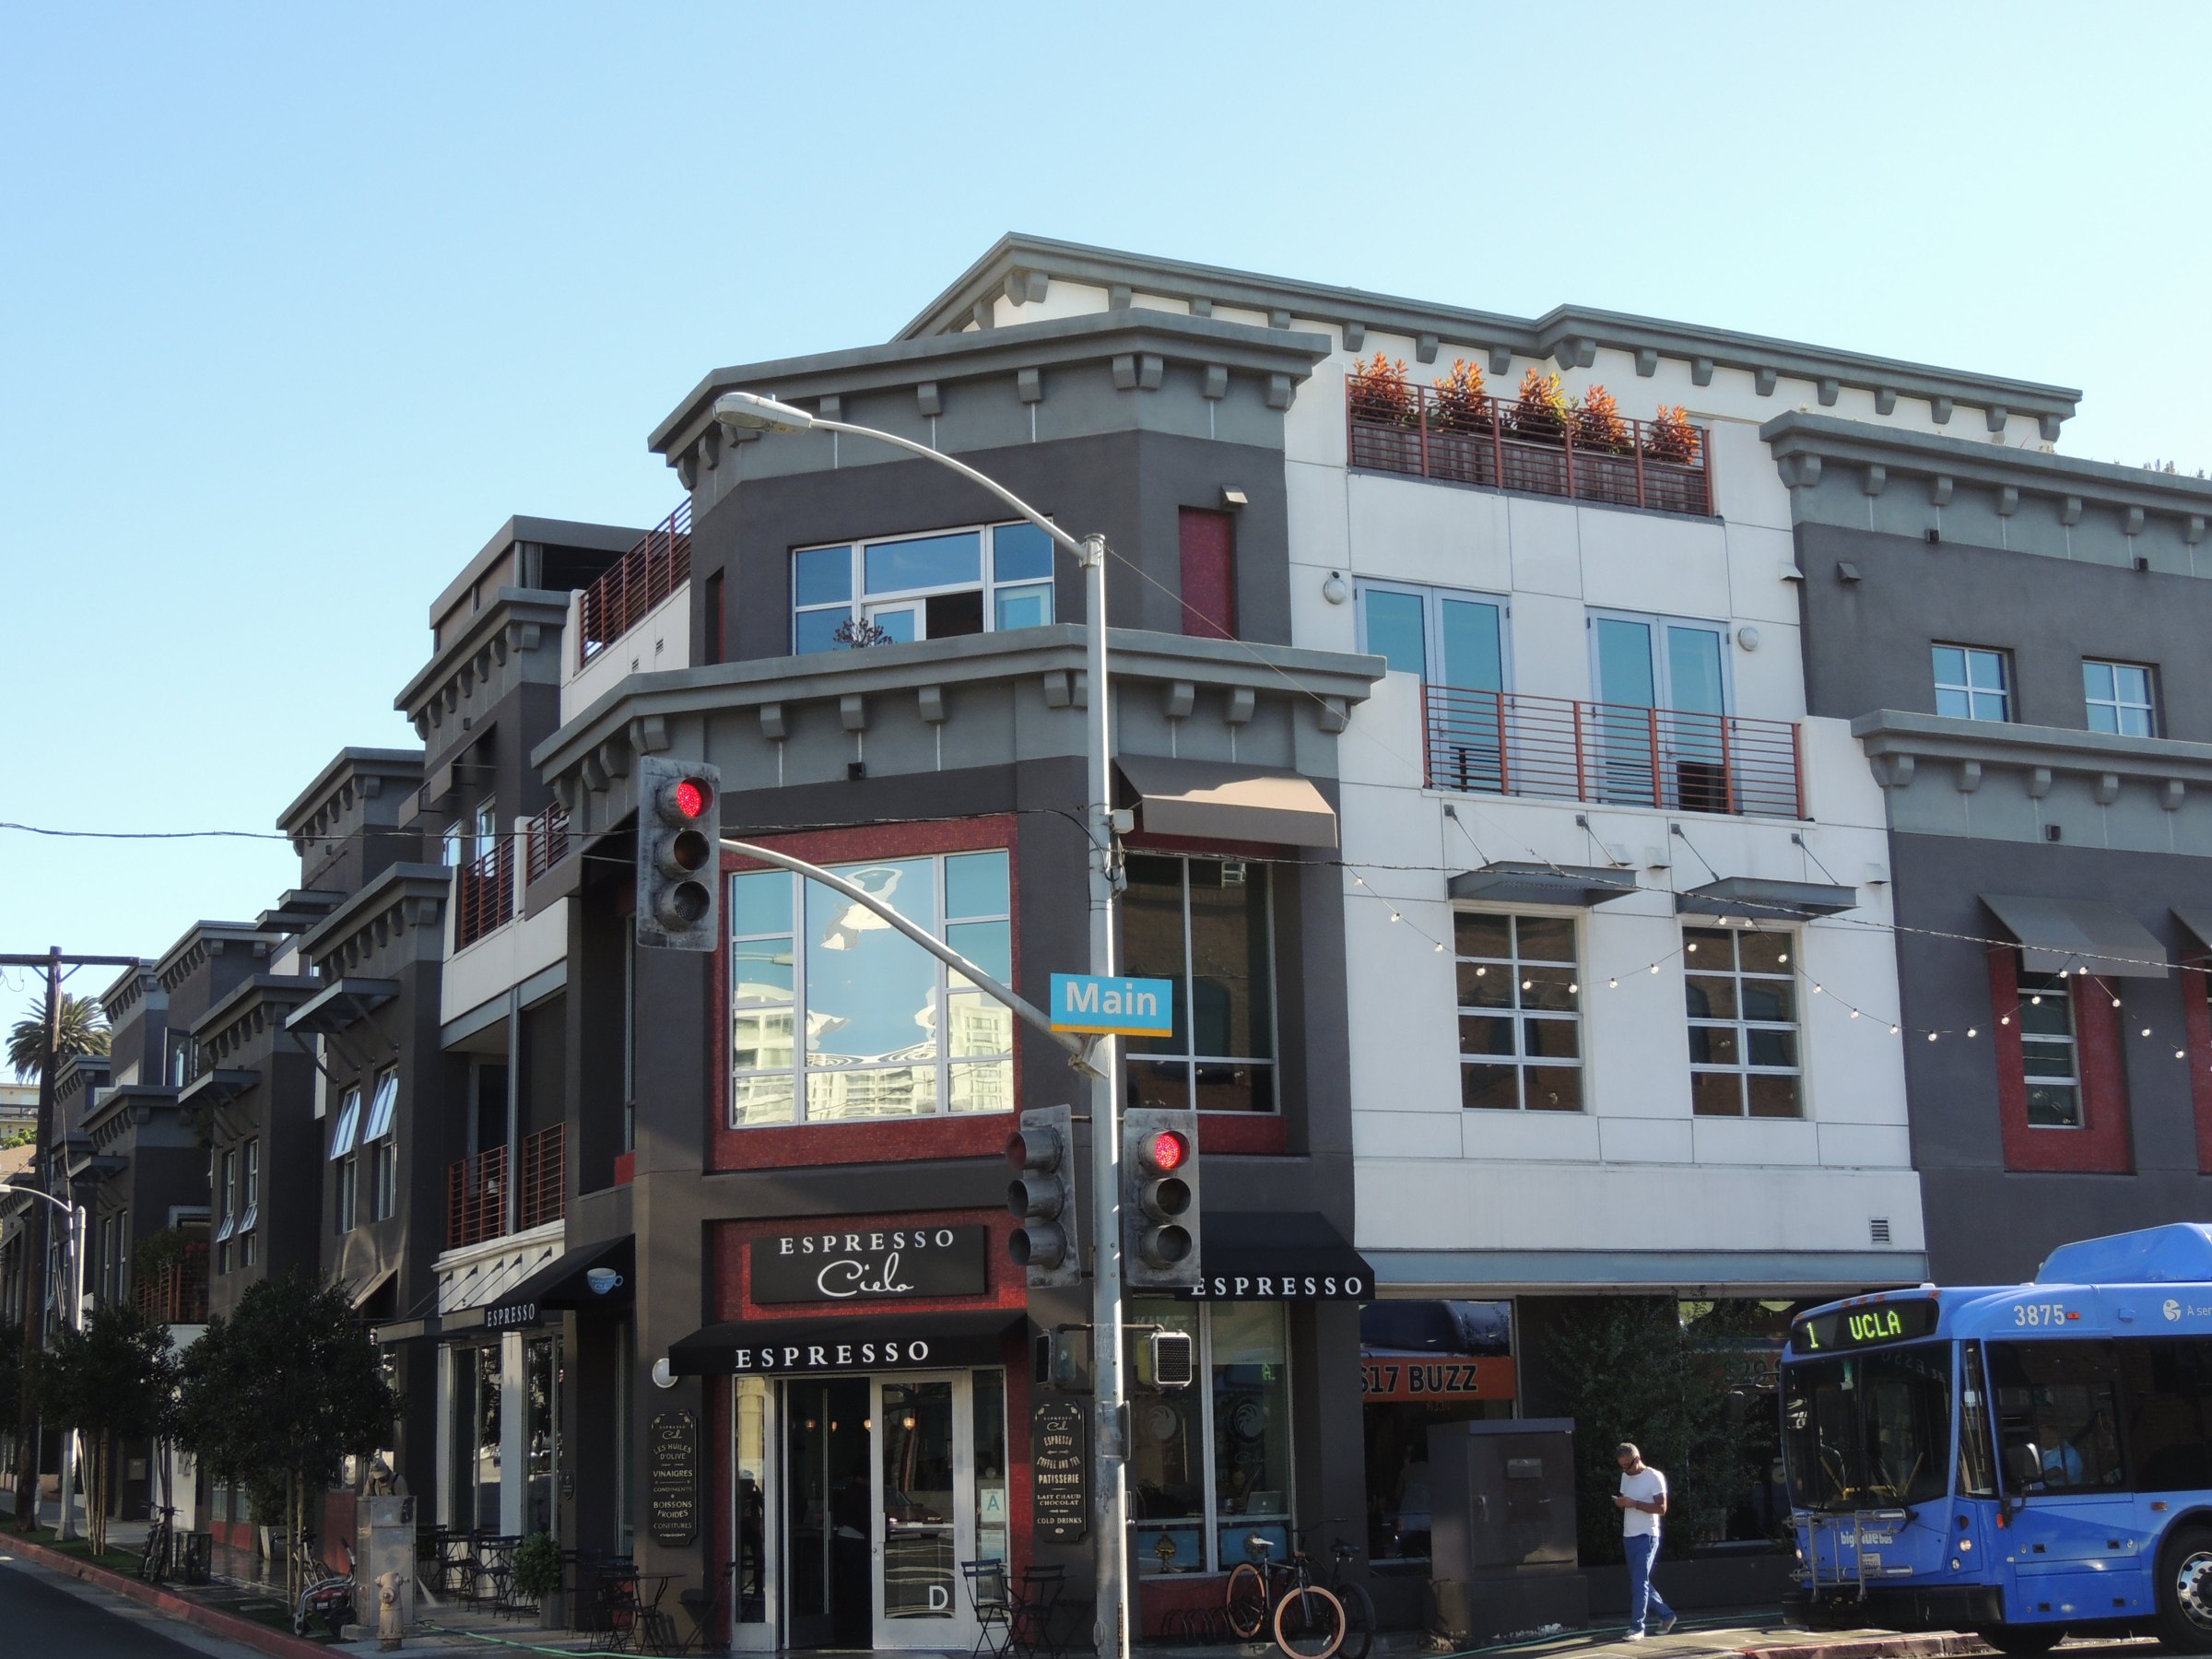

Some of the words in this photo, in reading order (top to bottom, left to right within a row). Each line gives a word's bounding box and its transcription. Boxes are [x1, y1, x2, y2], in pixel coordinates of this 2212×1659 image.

[1066, 982, 1157, 1016] Main
[780, 1230, 954, 1254] ESPRESSO
[818, 1252, 914, 1297] Cielo
[1191, 1277, 1362, 1295] ESPRESSO
[487, 1303, 535, 1327] ESPRESSO
[2013, 1304, 2065, 1325] 3875
[2187, 1305, 2194, 1316] A
[1806, 1322, 1818, 1348] 1
[1849, 1310, 1901, 1340] UCLA
[735, 1341, 929, 1368] ESPRESSO
[1408, 1364, 1478, 1393] BUZZ
[653, 1444, 666, 1454] LES
[667, 1443, 692, 1453] HUILES
[1043, 1435, 1073, 1447] ESPRESSO
[1038, 1474, 1079, 1484] PATISSERIE
[653, 1500, 693, 1509] BOISSONS
[987, 1495, 1000, 1511] A
[657, 1510, 688, 1519] FROIDES
[1841, 1530, 1854, 1547] big
[1854, 1527, 1878, 1545] lue
[1880, 1533, 1892, 1545] bus
[929, 1585, 948, 1610] D
